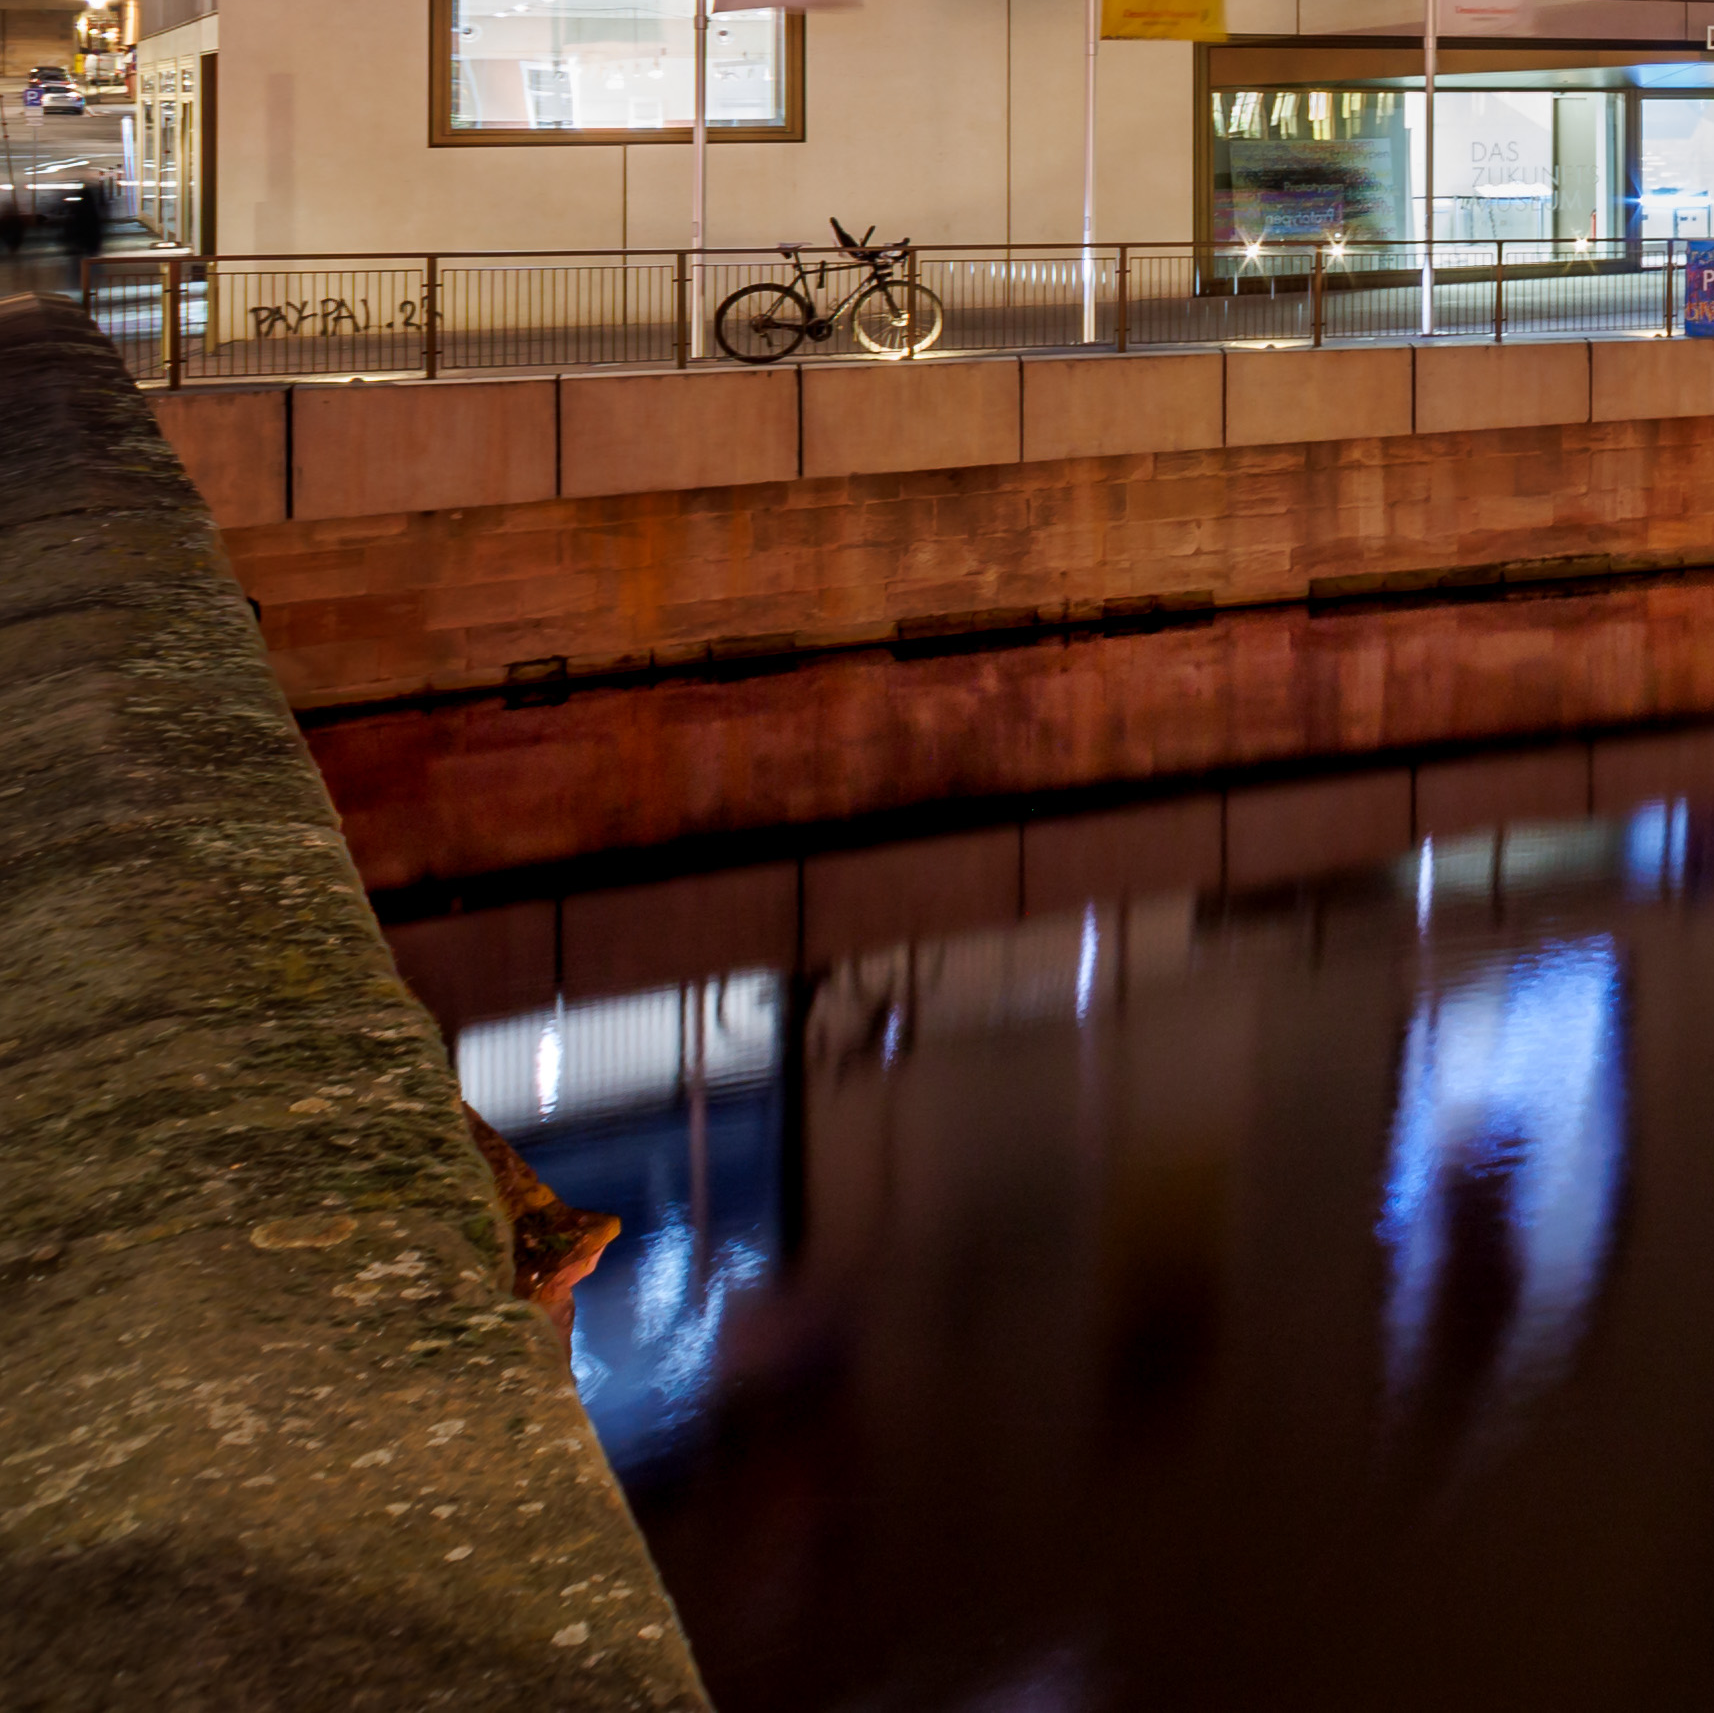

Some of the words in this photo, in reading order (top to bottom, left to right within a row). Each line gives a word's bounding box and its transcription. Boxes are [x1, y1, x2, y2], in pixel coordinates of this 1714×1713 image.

[27, 90, 39, 104] P
[1472, 141, 1519, 162] DAS
[1472, 165, 1599, 188] ZUKUNFTS
